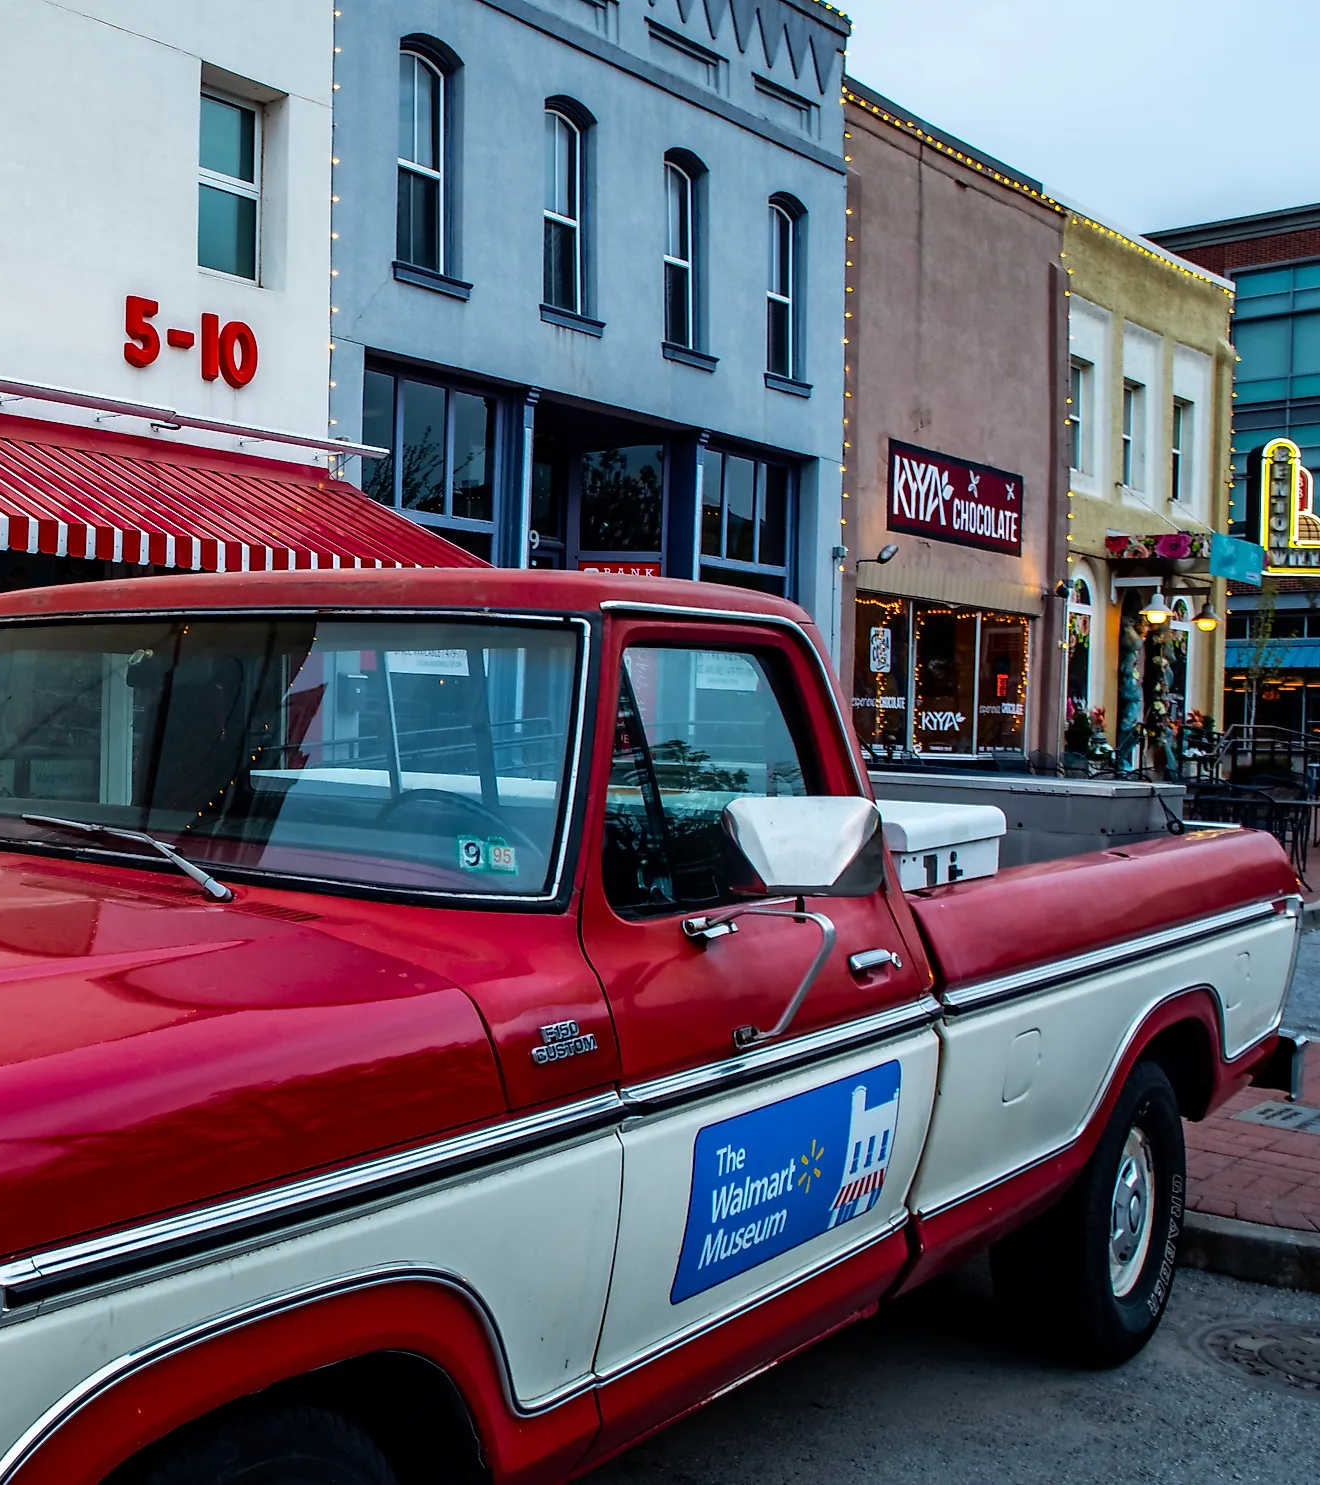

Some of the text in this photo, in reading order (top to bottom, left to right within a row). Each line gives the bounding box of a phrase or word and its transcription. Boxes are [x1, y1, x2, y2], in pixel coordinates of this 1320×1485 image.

[124, 295, 258, 389] 5-10
[893, 454, 1019, 543] KYYA CHOCOLATE
[1271, 446, 1289, 549] BENTON
[921, 711, 960, 731] KYYA
[465, 842, 512, 866] 9 95
[532, 1034, 597, 1064] CUSTOM
[541, 1020, 579, 1043] F150
[716, 1144, 746, 1177] The
[711, 1158, 796, 1223] Walmart
[697, 1208, 788, 1270] Museum
